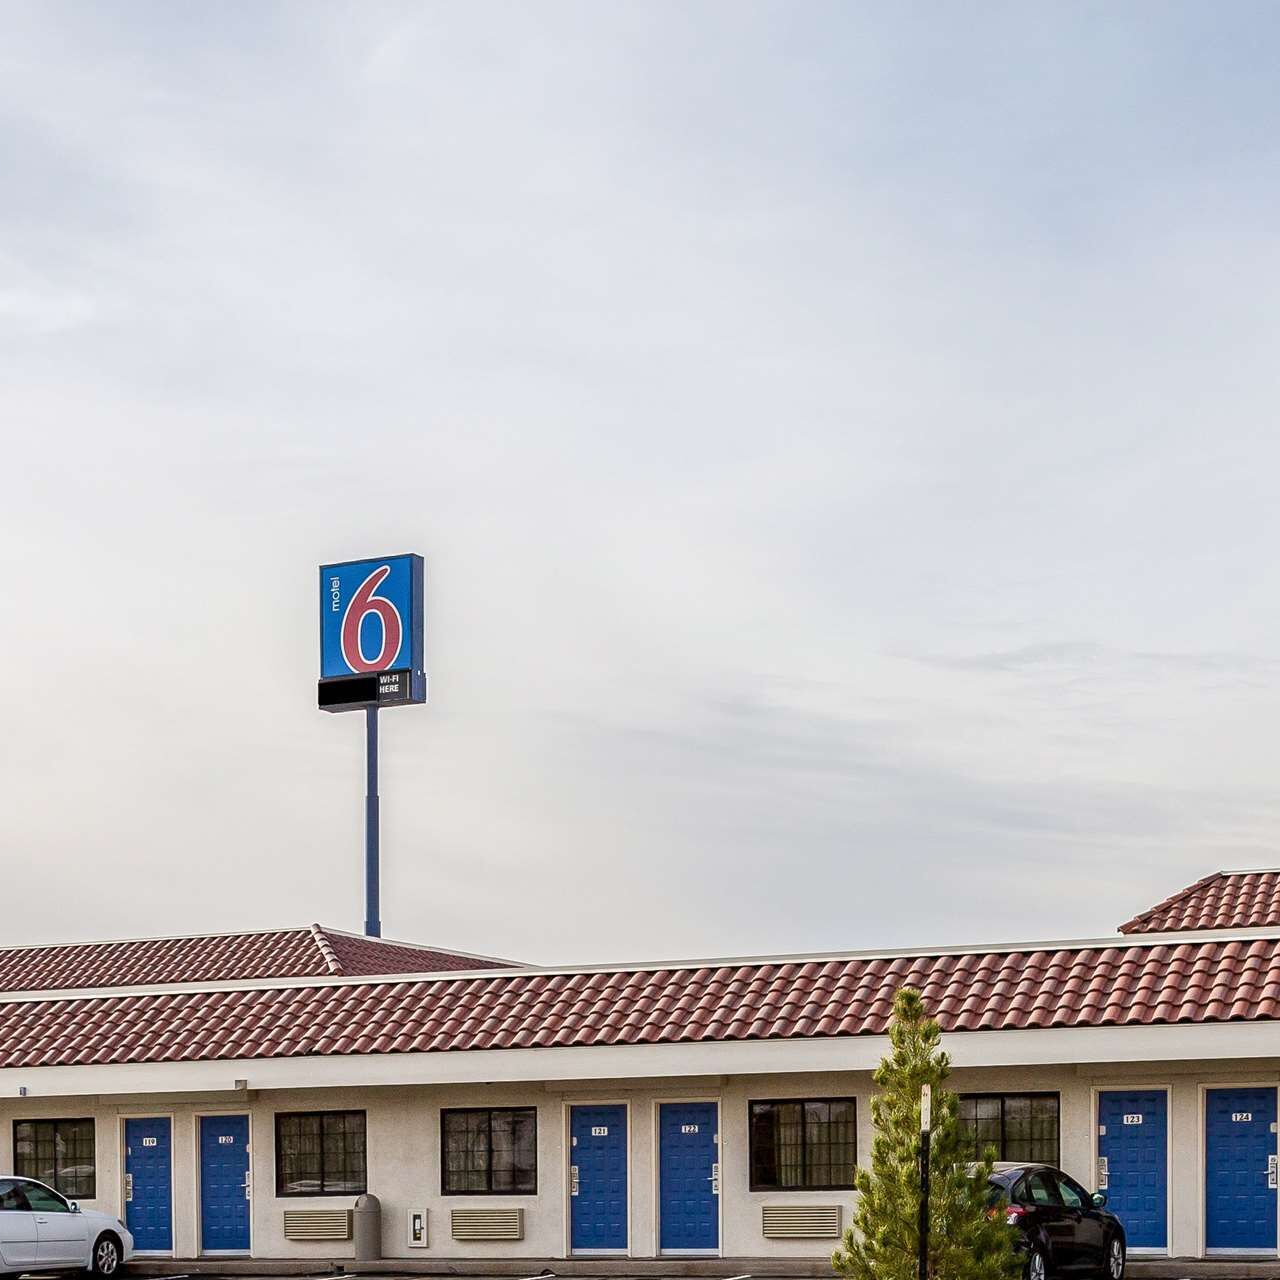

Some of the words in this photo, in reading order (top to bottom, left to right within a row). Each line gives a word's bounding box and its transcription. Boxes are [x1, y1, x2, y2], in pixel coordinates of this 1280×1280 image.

[330, 576, 340, 612] motel
[340, 564, 403, 674] 6
[379, 674, 399, 684] WI-FI
[379, 684, 400, 693] HERE
[1125, 1115, 1141, 1123] 123
[1234, 1113, 1250, 1121] 124
[593, 1127, 607, 1135] 121
[683, 1125, 698, 1133] 122
